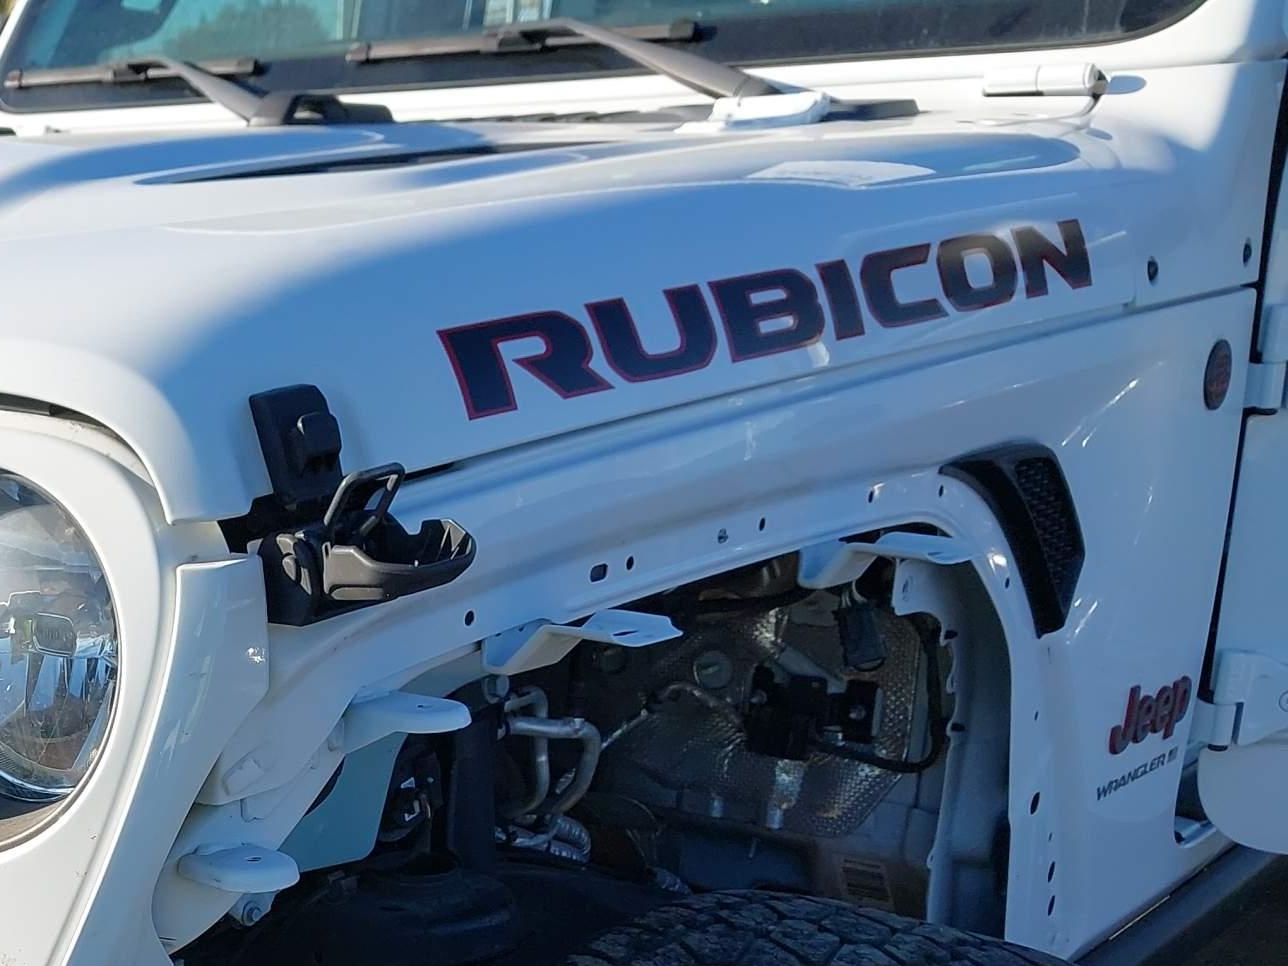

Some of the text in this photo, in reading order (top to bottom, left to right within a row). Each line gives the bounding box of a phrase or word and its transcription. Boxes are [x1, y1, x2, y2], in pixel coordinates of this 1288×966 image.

[437, 219, 1092, 420] RUBICON
[1109, 676, 1192, 755] Jeep
[1096, 753, 1166, 801] WRANGLER
